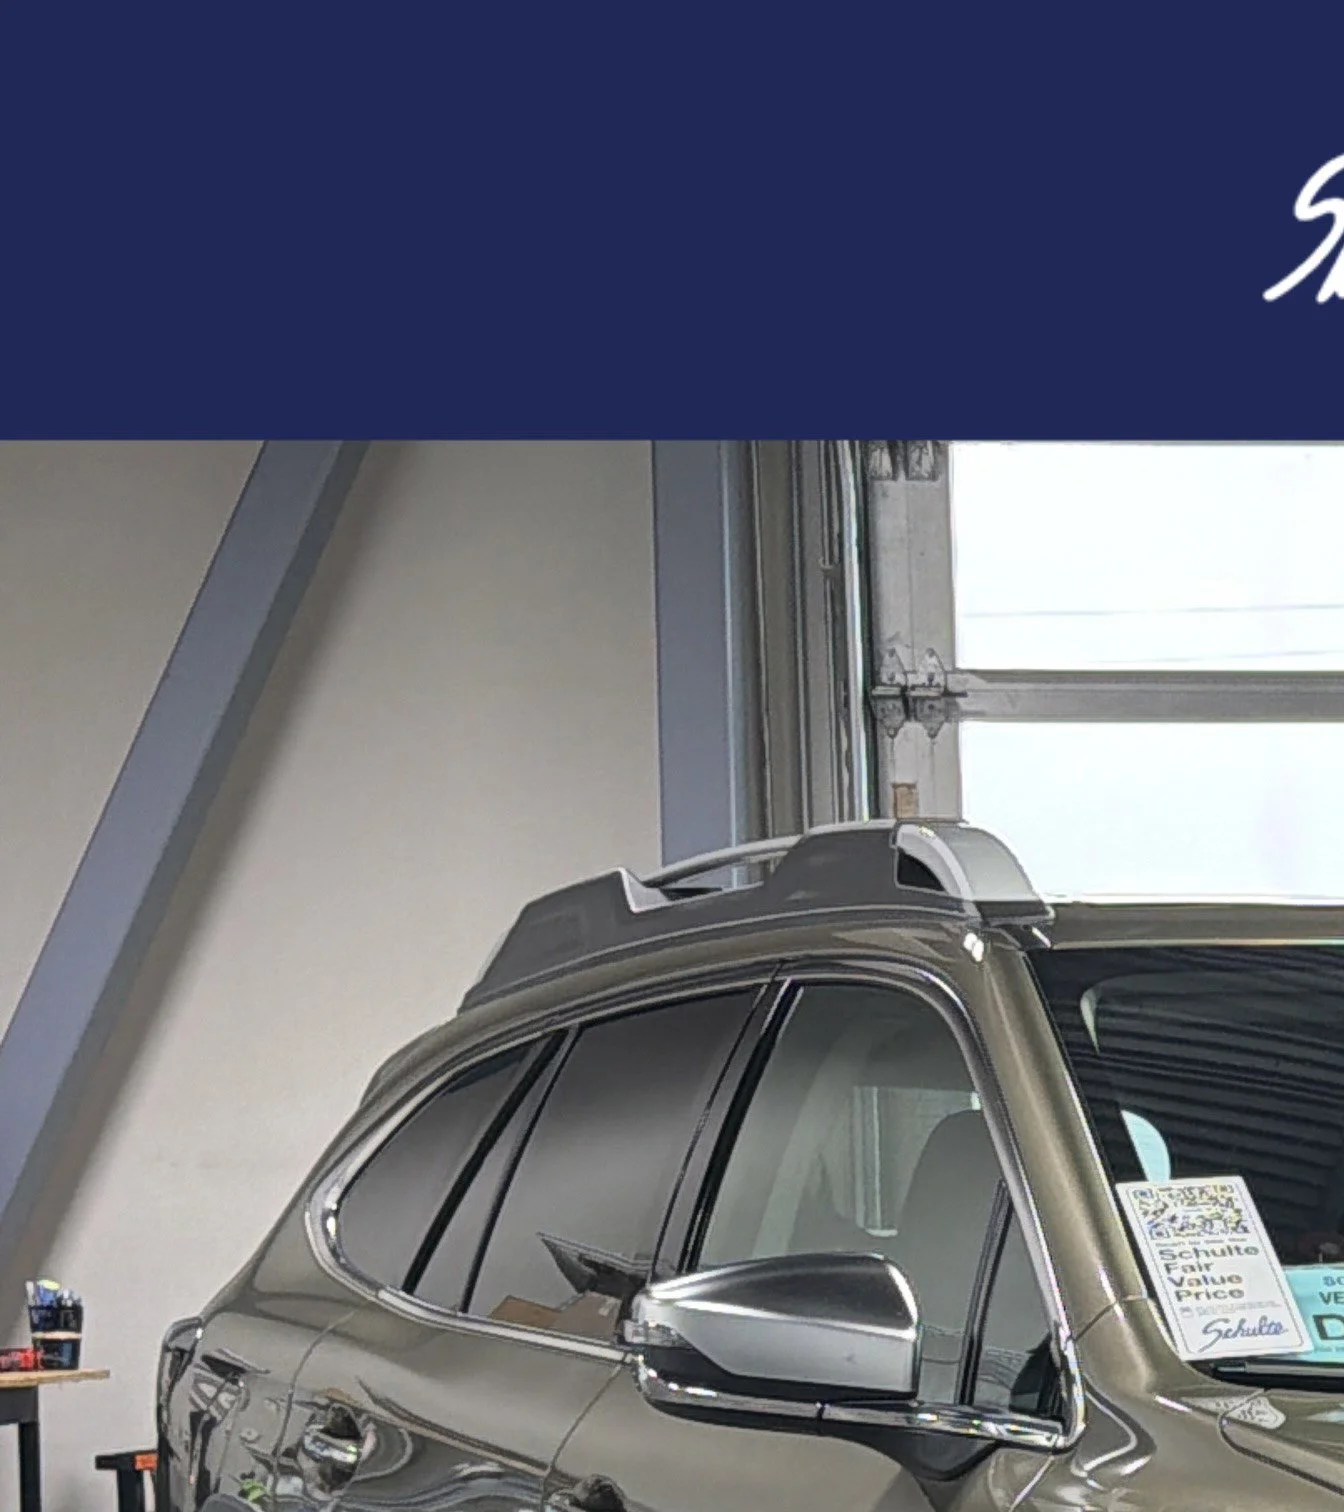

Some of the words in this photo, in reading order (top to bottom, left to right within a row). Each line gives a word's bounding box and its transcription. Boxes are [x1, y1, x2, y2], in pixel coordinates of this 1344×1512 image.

[1158, 1244, 1260, 1261] Schulte
[1164, 1260, 1215, 1274] Fair
[1167, 1273, 1244, 1288] Value
[1174, 1287, 1245, 1303] Price
